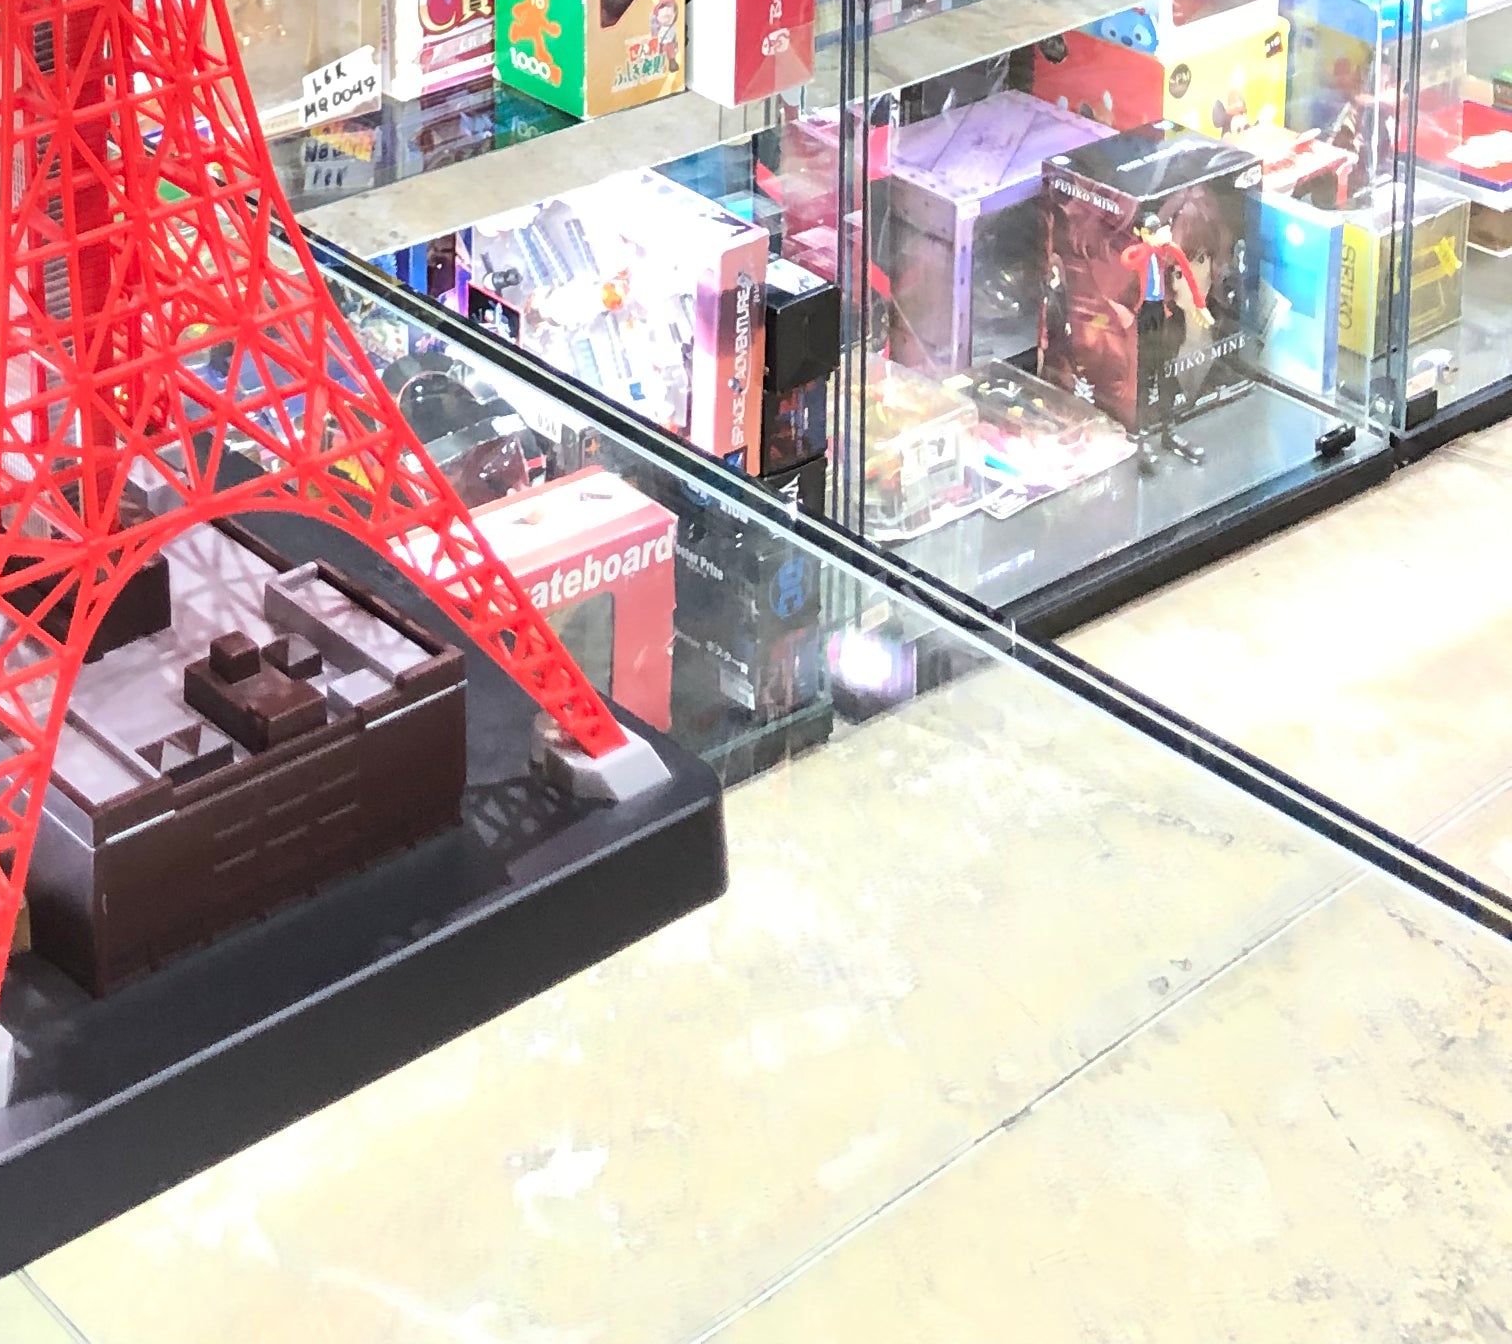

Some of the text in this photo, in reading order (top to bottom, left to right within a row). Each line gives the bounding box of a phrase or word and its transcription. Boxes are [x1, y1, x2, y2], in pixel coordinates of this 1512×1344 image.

[1054, 179, 1122, 215] FUJIKO MINE
[1338, 241, 1356, 332] SEIKO
[730, 287, 752, 446] SPACE ADVENTURE
[1163, 334, 1247, 380] UJIKO MINE
